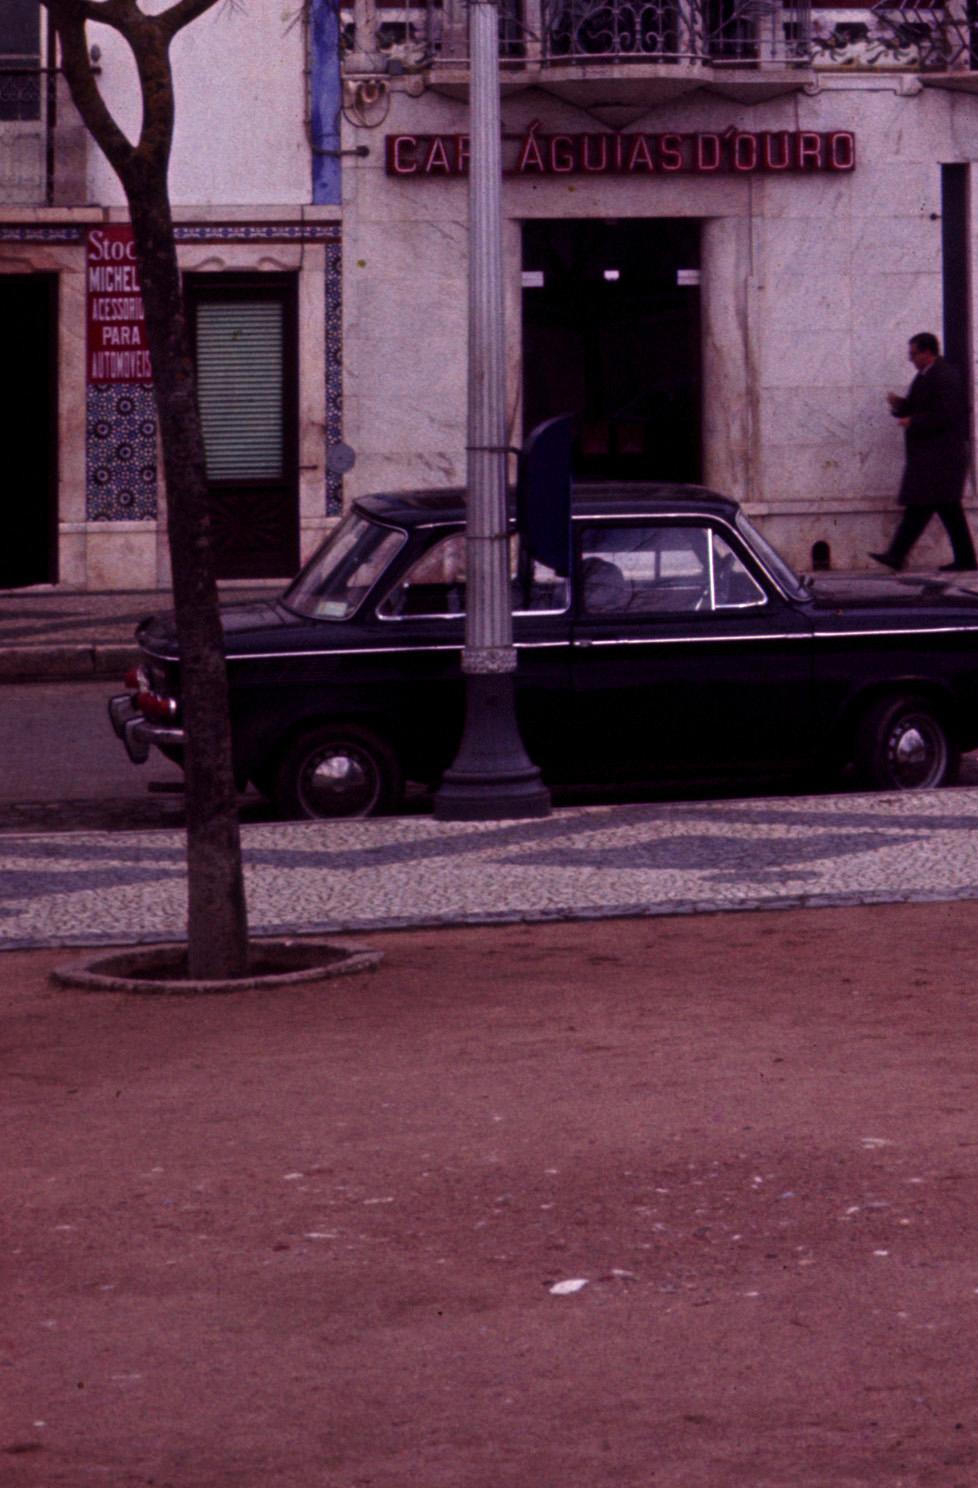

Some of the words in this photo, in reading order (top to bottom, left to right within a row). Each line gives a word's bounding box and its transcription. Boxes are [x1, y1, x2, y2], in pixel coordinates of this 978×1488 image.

[393, 134, 473, 173] CAF
[519, 119, 684, 173] ÁGUIAS
[698, 125, 855, 172] D'OURO
[89, 230, 137, 261] Stoc
[89, 266, 141, 292] MICHEL
[92, 297, 145, 321] ACESSORIO
[102, 325, 141, 346] PARA
